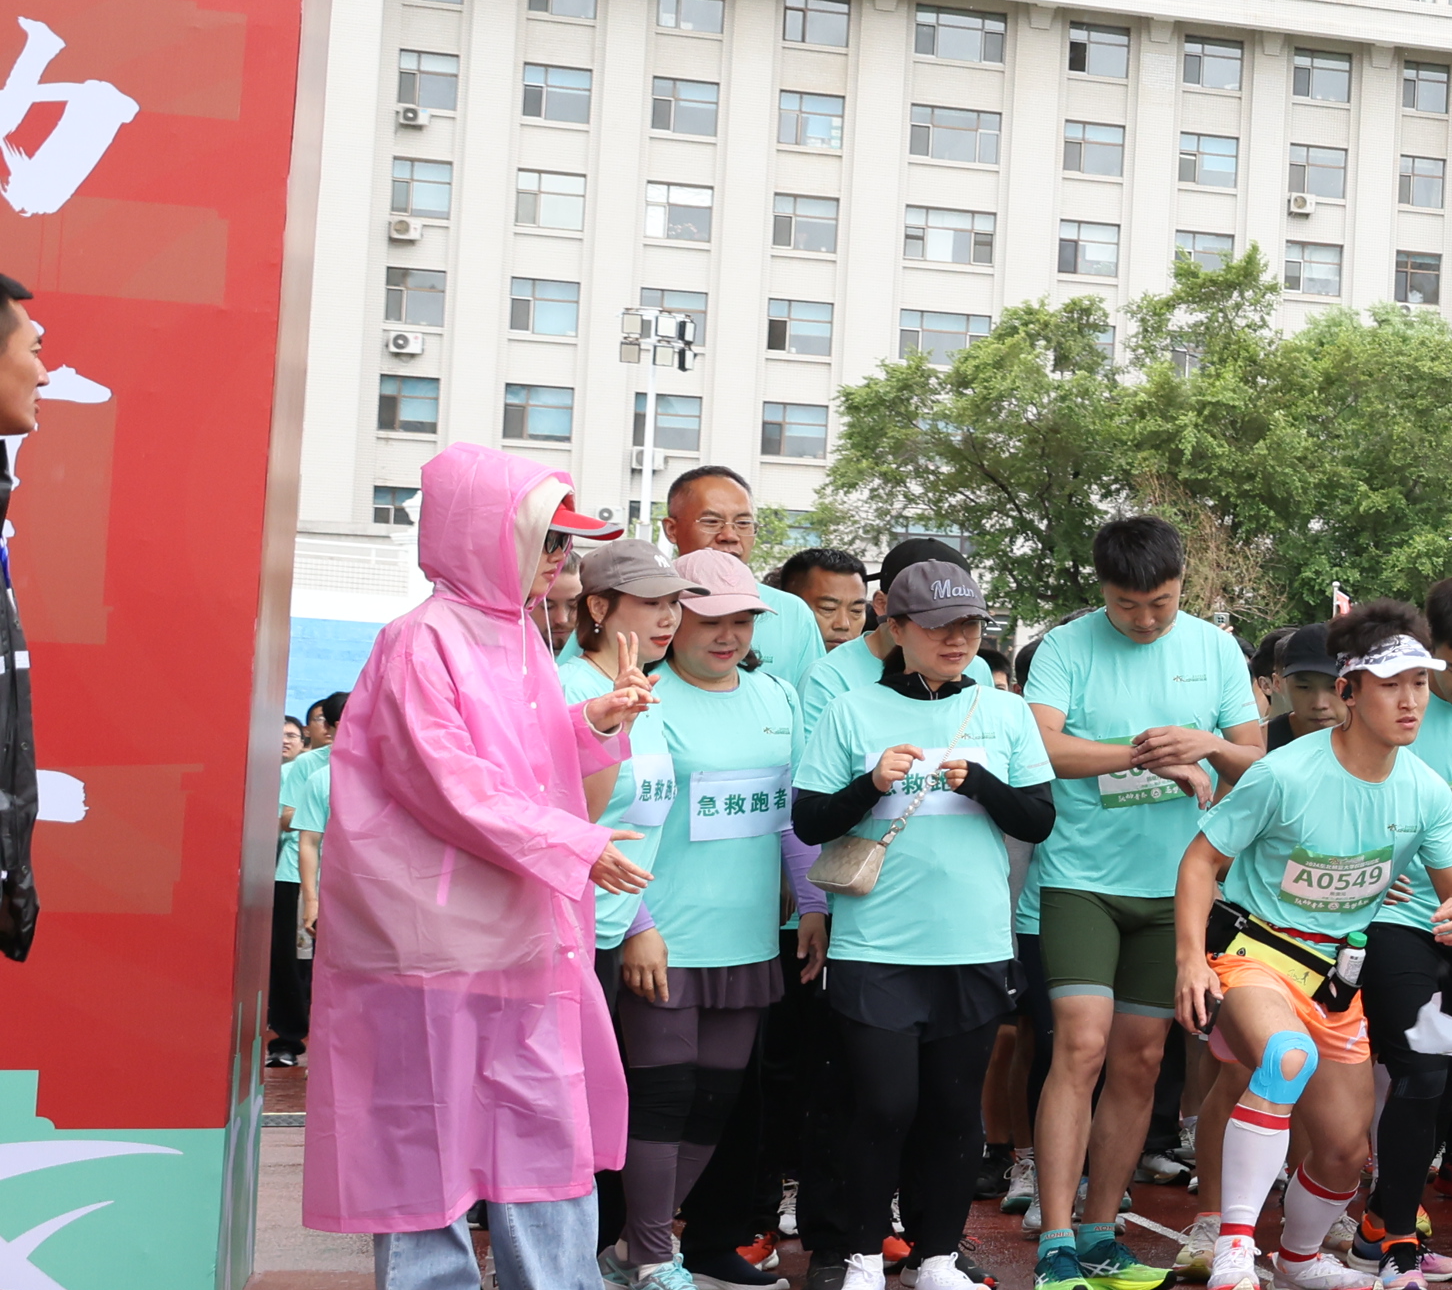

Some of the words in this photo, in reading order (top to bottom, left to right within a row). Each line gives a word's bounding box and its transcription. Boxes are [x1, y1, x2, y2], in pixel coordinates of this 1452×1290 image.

[697, 788, 788, 817] 急救跑者
[1292, 866, 1383, 891] A0549
